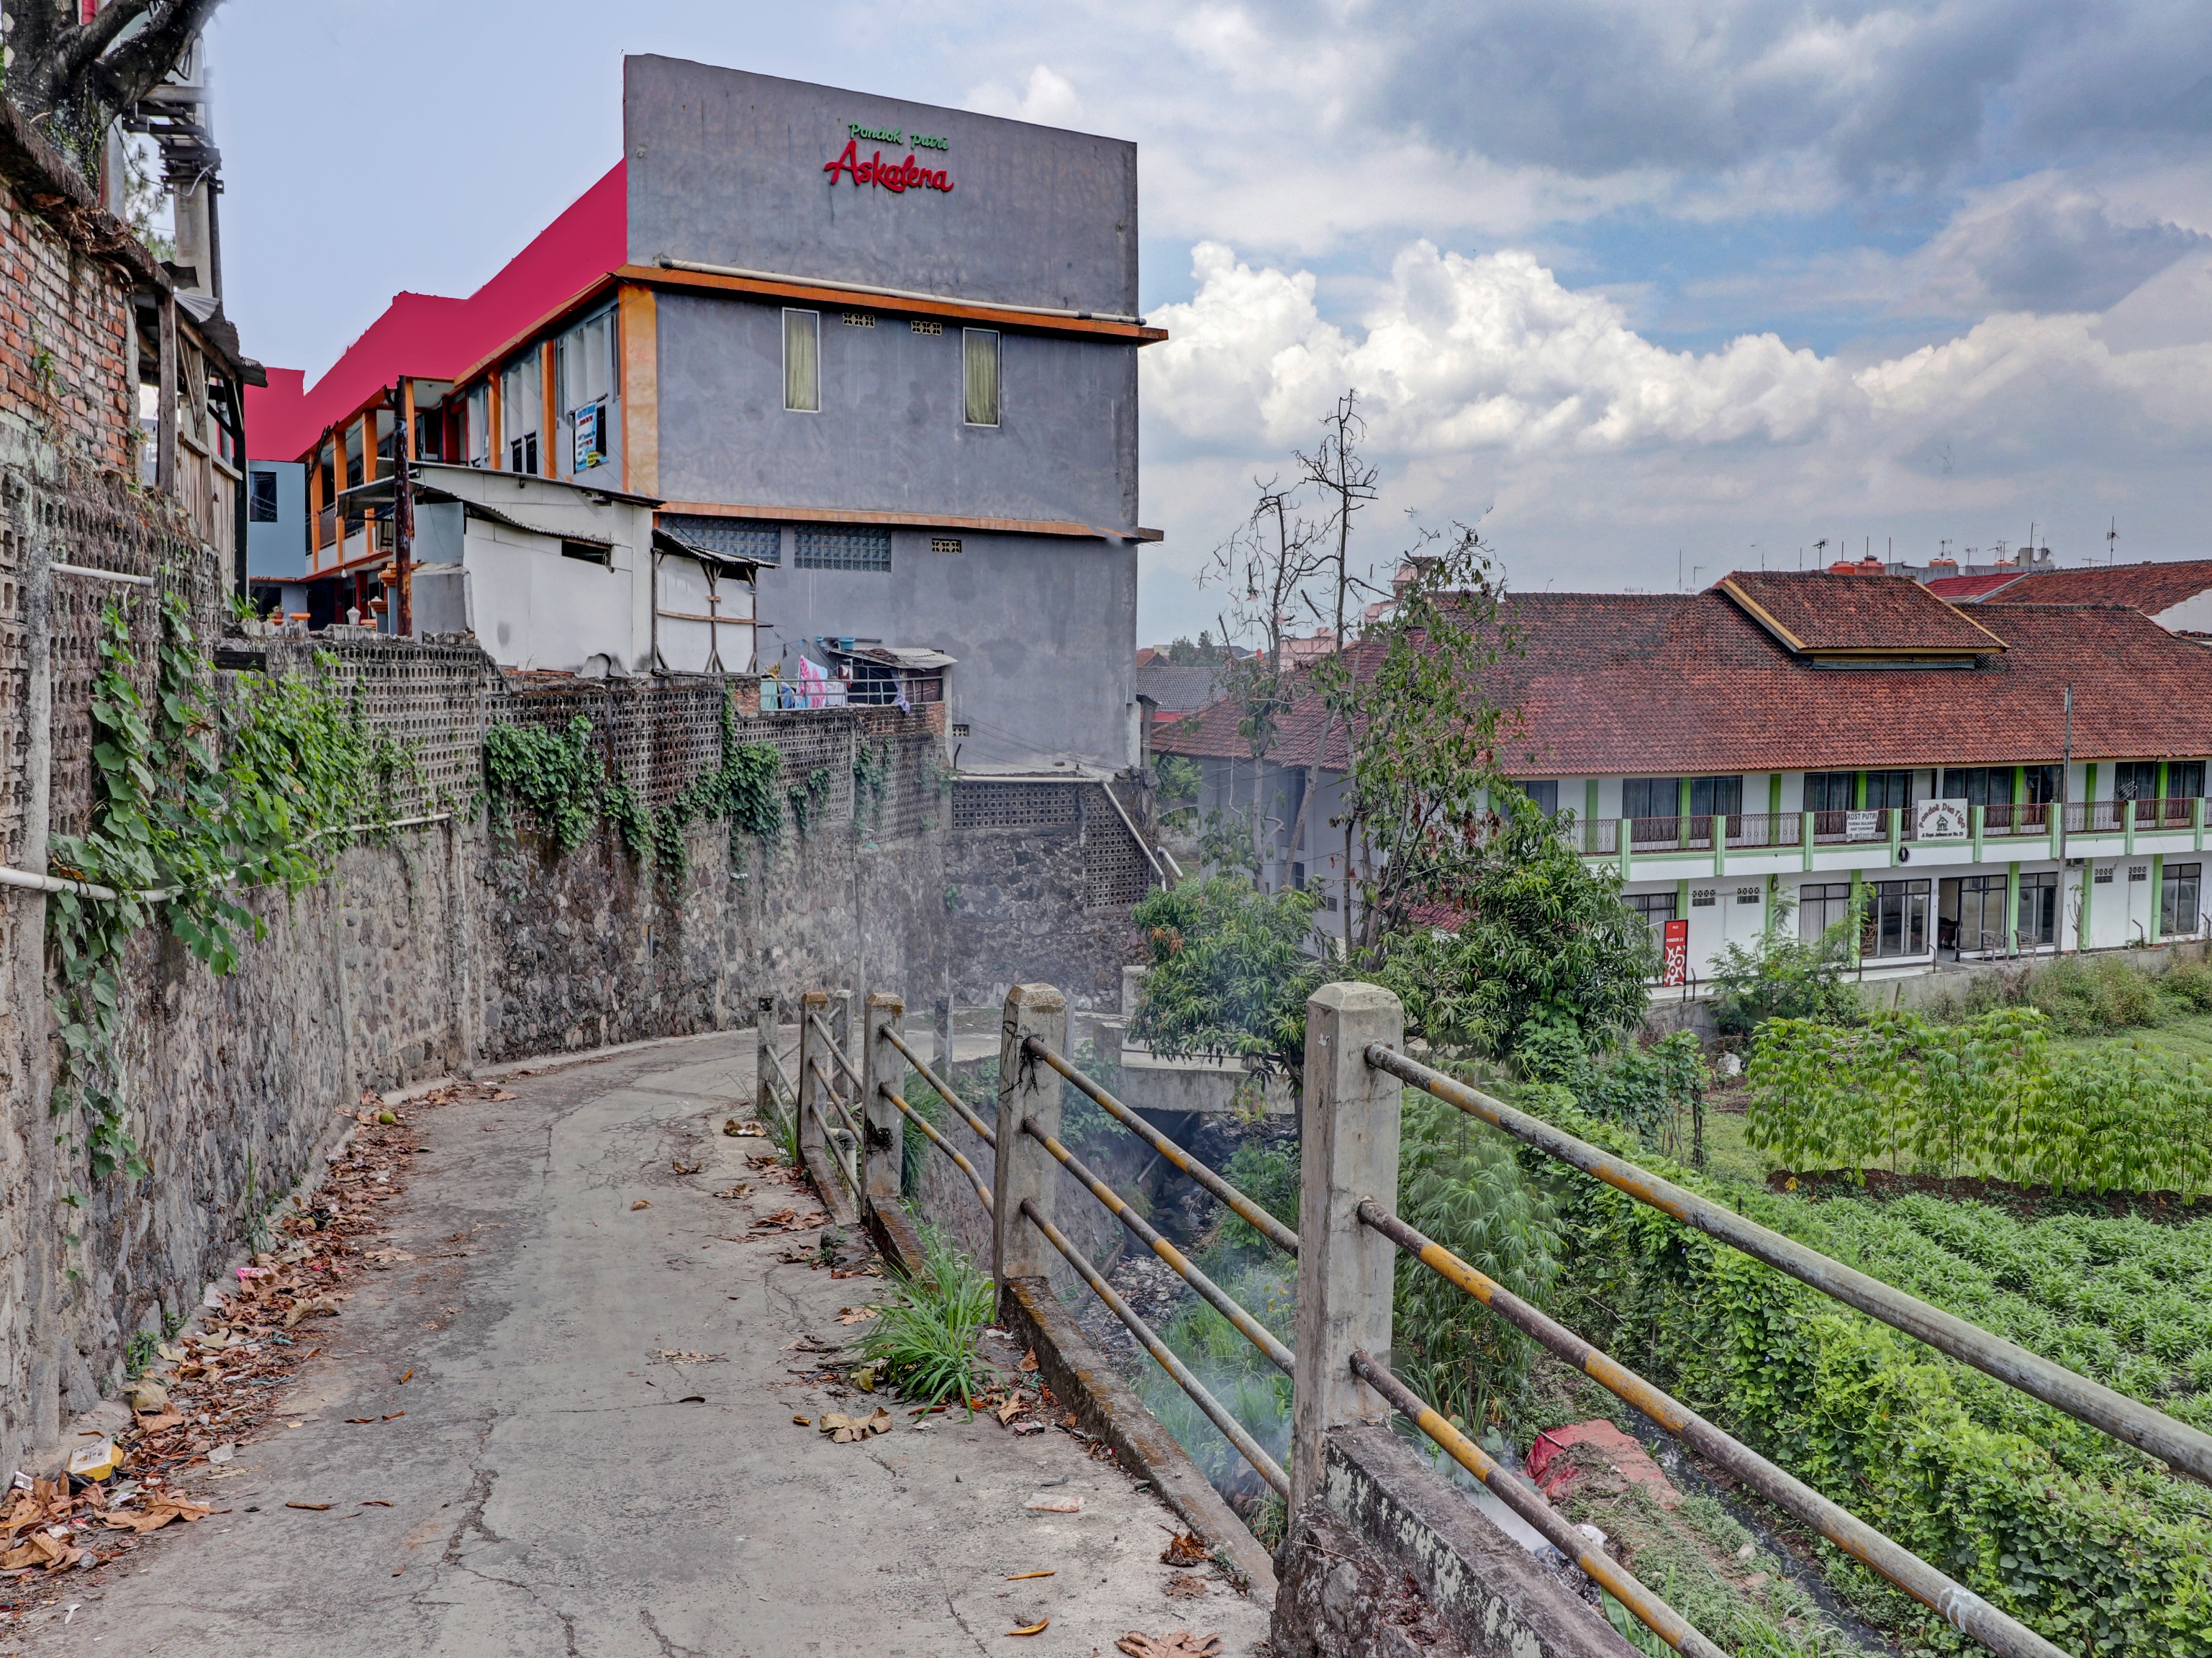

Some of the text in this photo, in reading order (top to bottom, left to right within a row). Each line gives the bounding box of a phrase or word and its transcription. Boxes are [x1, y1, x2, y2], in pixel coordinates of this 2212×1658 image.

[848, 122, 903, 144] Pondok
[824, 140, 954, 192] Askalena
[1918, 803, 1939, 828] Pondok
